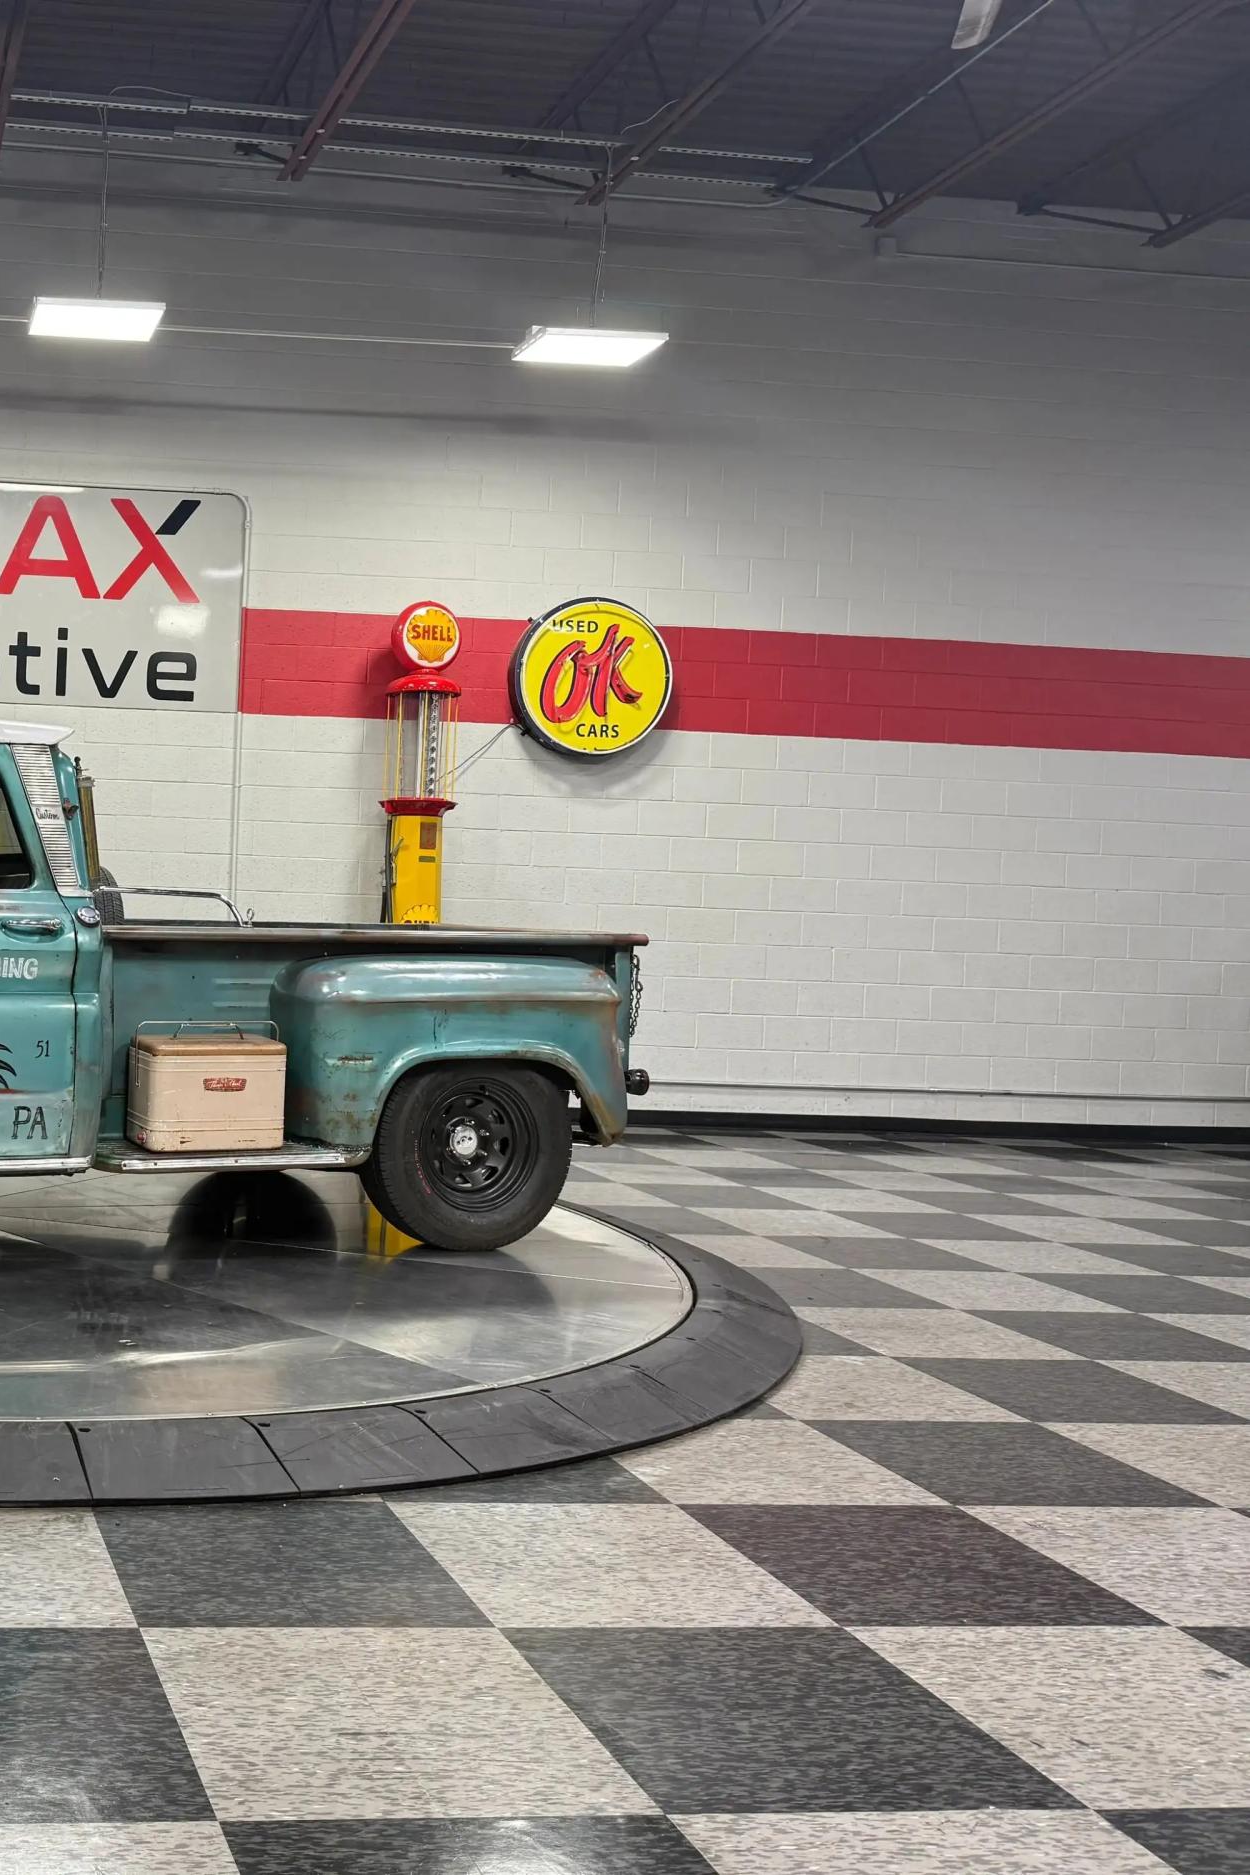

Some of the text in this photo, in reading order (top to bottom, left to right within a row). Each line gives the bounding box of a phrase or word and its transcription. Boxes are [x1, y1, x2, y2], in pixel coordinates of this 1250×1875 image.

[411, 624, 453, 643] SHELL
[551, 619, 599, 633] USED
[539, 623, 643, 723] OK
[576, 723, 619, 738] CARS
[35, 1040, 50, 1058] 51
[11, 1106, 48, 1139] PA
